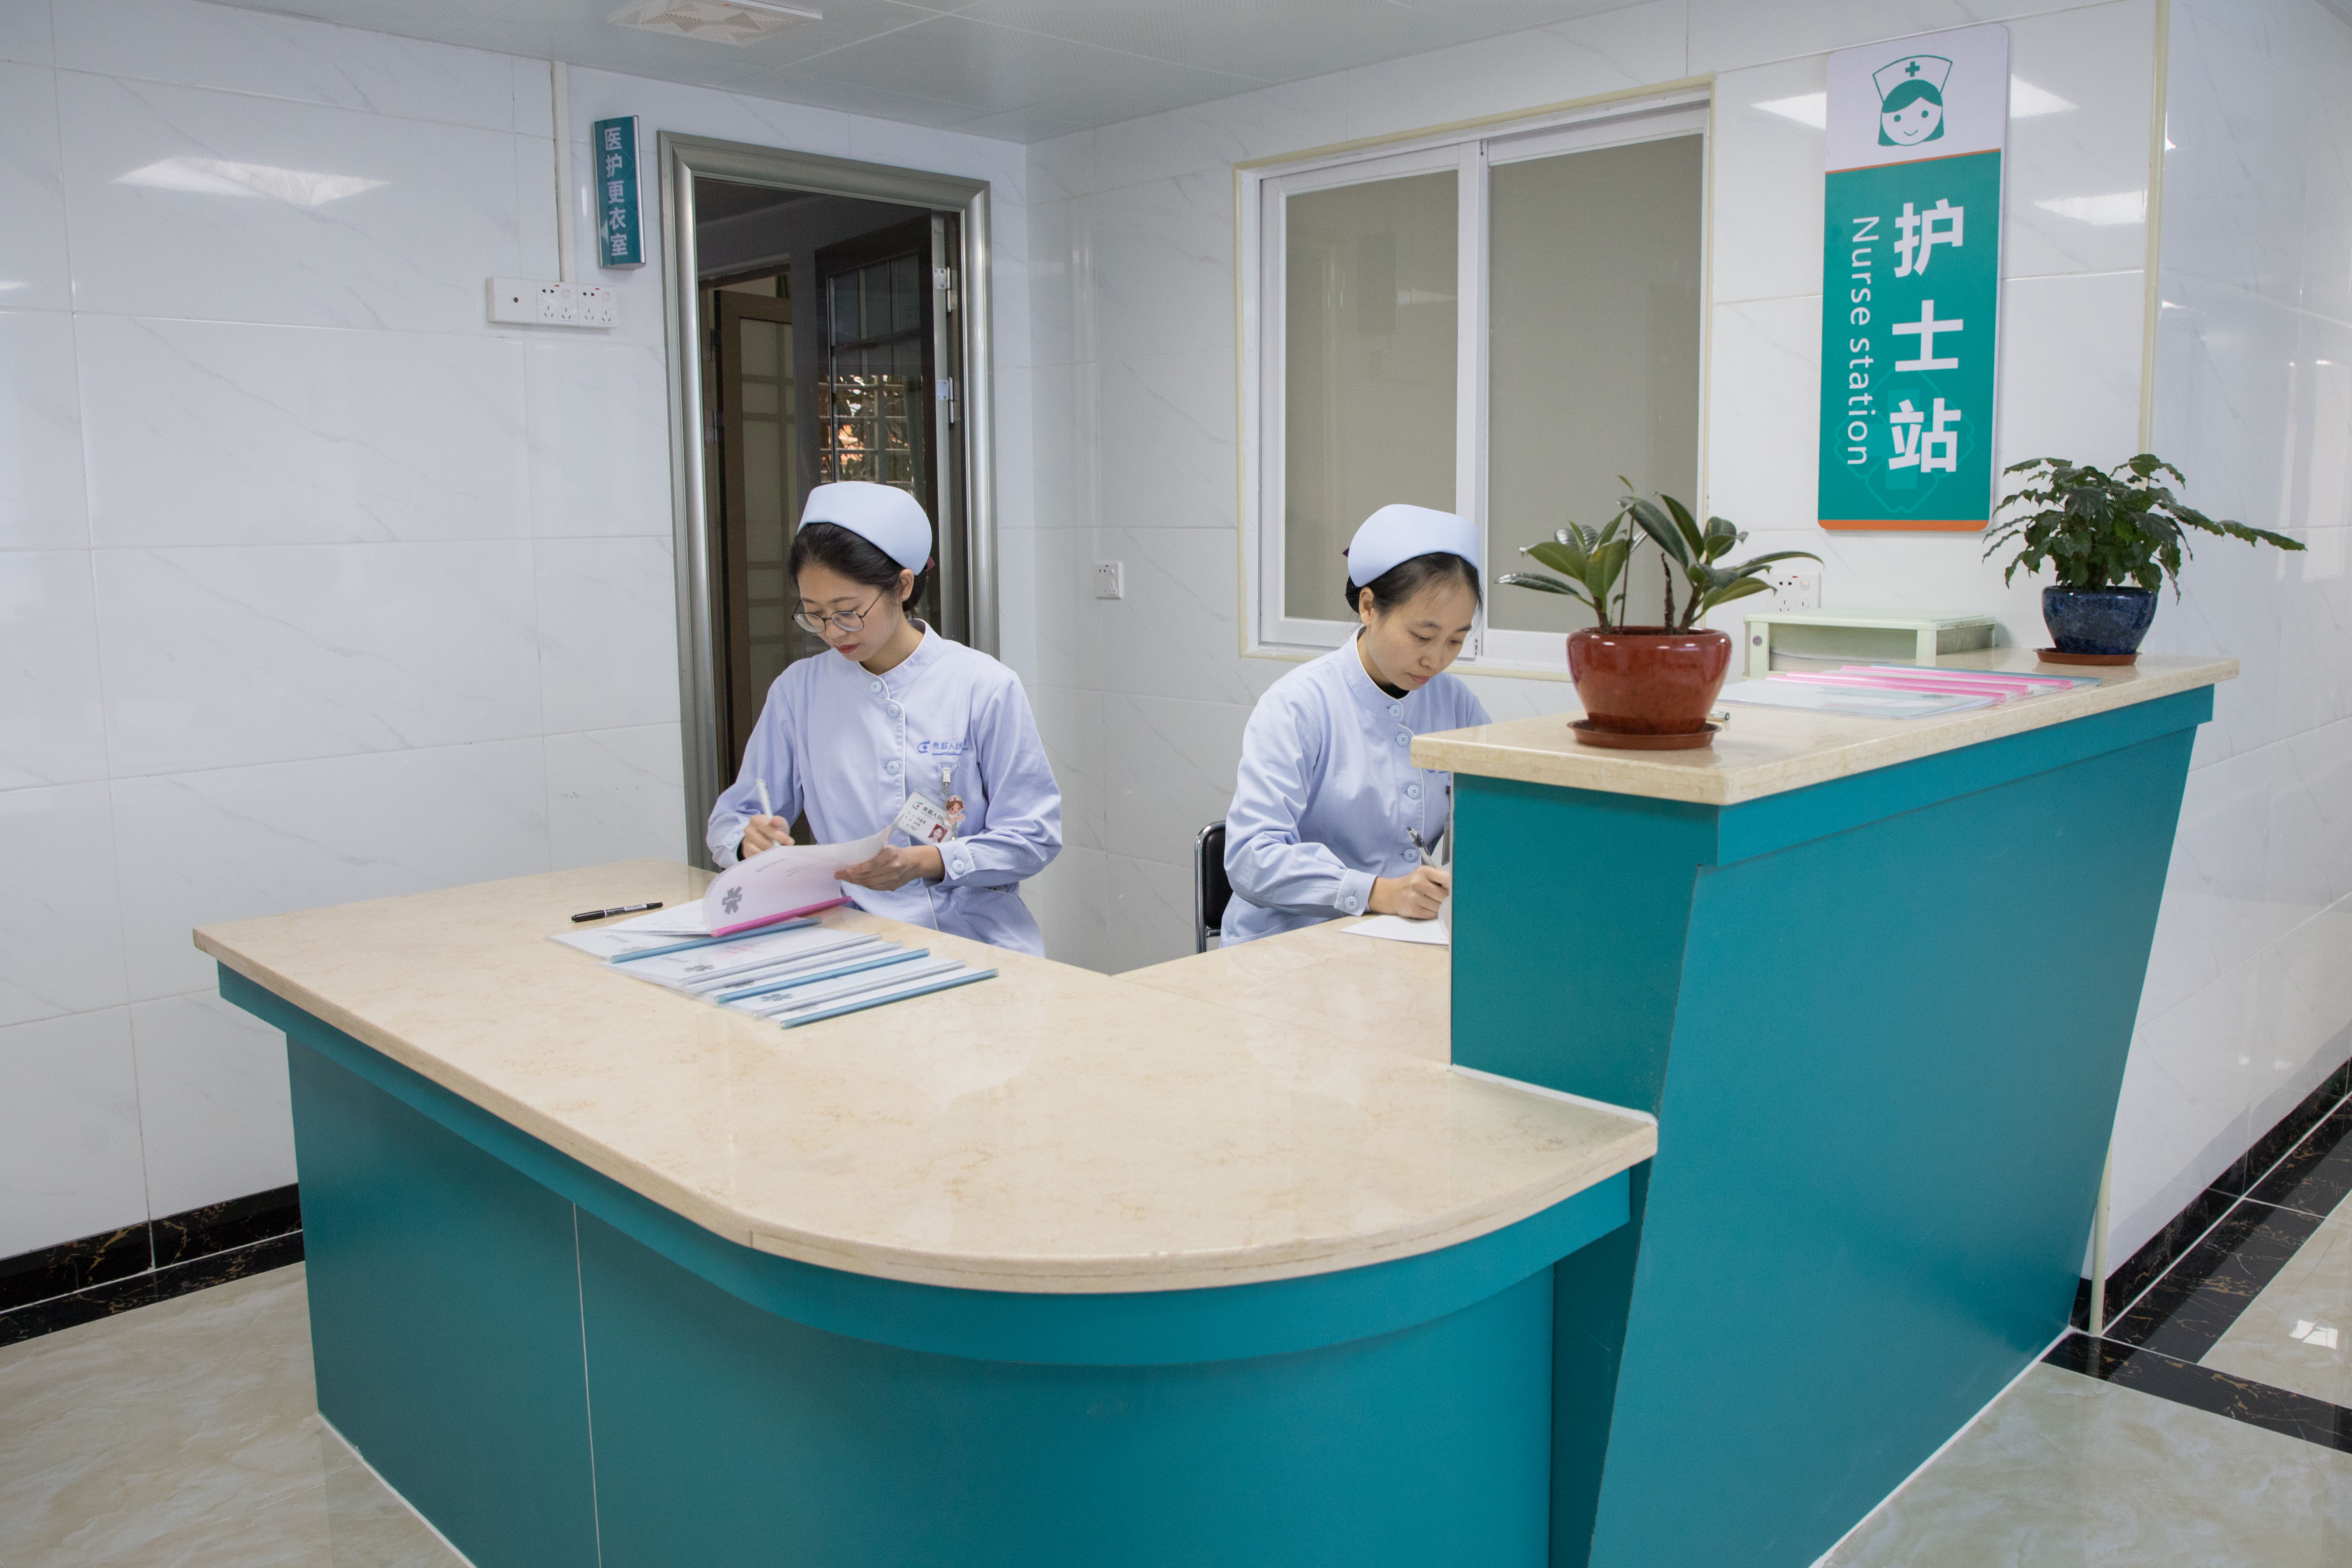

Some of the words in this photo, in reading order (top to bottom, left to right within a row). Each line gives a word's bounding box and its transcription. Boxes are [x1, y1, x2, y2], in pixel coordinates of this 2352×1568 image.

[604, 127, 628, 256] 医护更衣室
[1850, 215, 1880, 326] Nurse
[1889, 198, 1965, 473] 护士站
[1847, 338, 1875, 466] station
